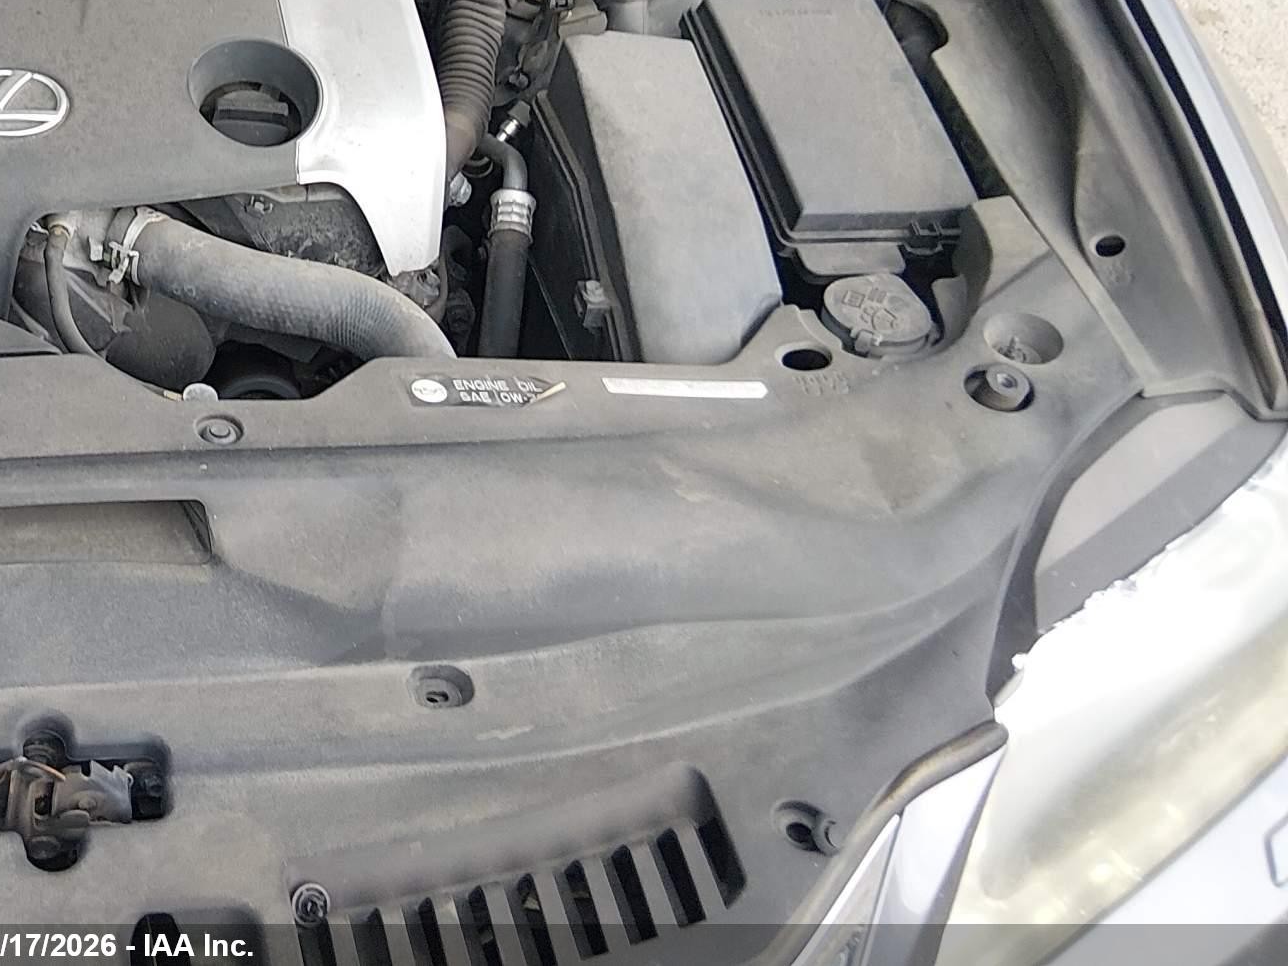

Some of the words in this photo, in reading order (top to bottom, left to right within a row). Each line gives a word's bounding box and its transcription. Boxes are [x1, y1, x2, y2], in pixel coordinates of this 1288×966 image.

[452, 379, 510, 391] ENGINE
[517, 380, 543, 392] OIL
[460, 391, 492, 403] SAE
